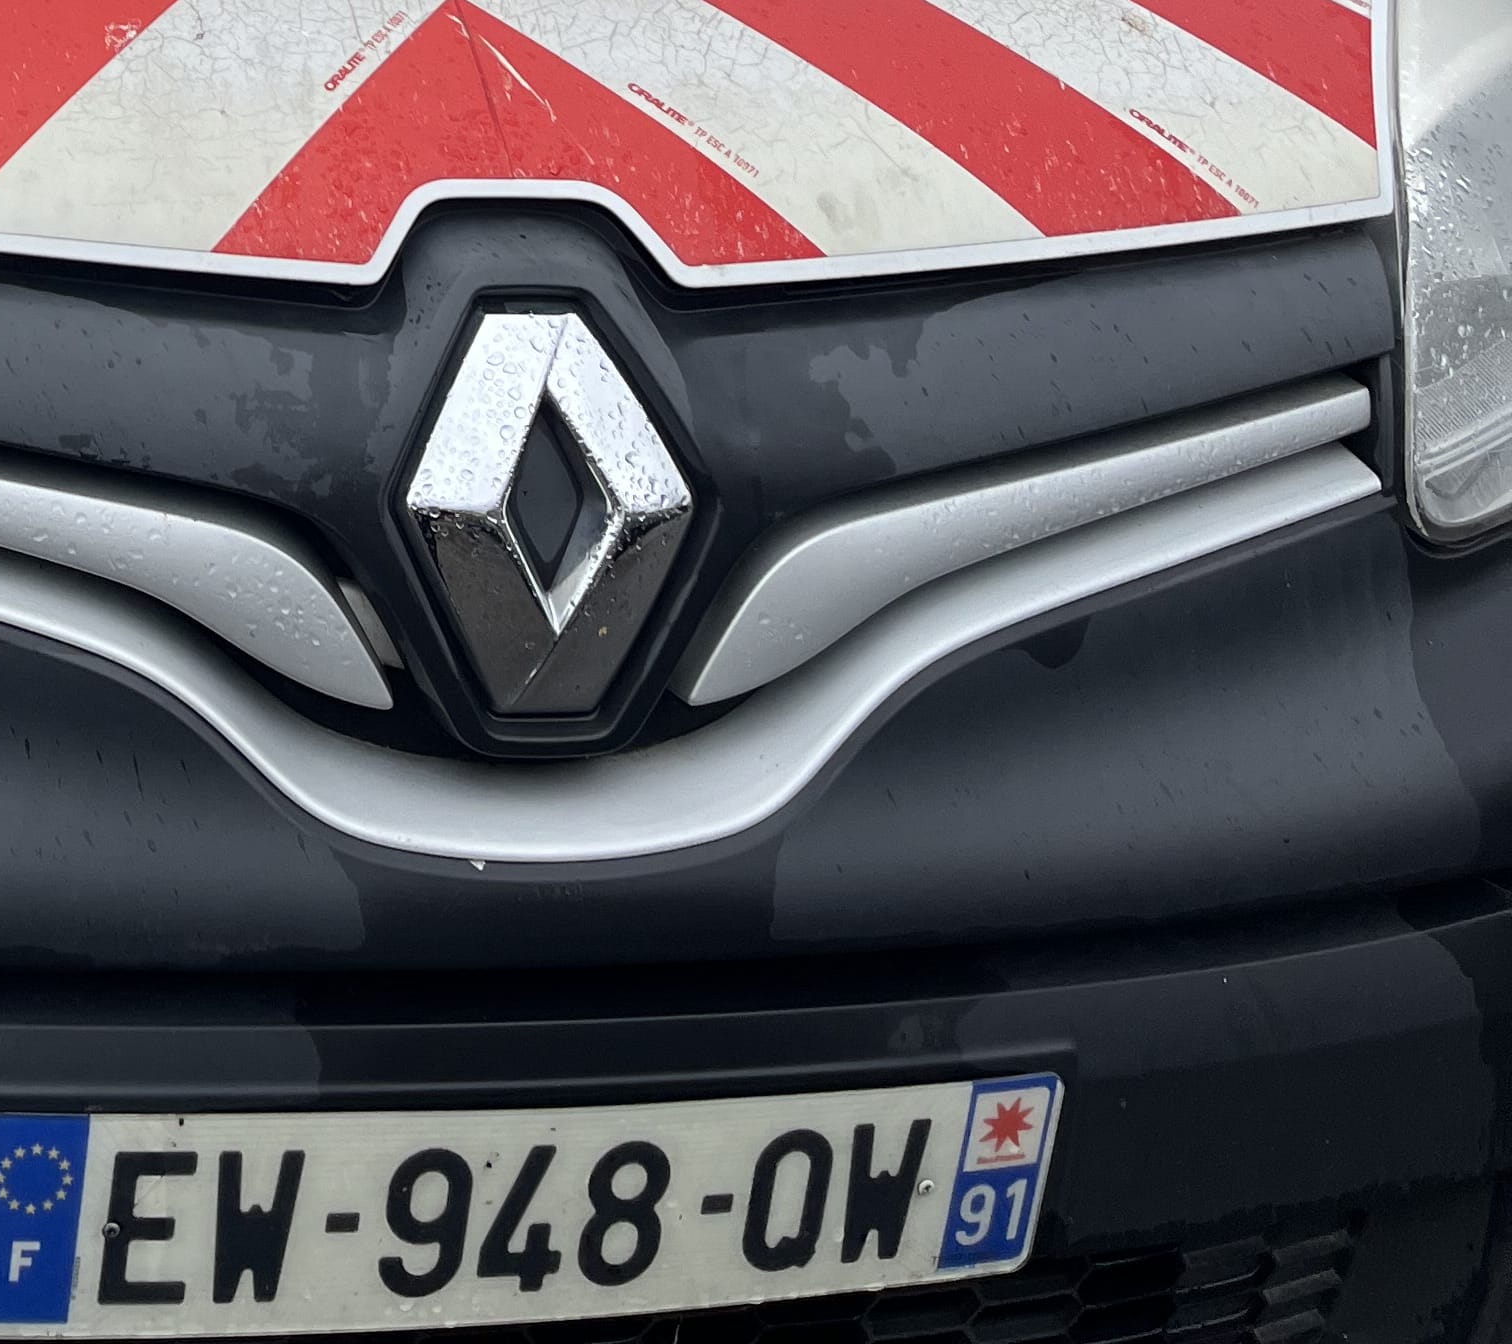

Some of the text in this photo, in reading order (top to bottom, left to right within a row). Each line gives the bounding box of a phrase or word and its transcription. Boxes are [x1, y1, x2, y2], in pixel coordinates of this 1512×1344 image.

[694, 126, 707, 139] TP
[706, 135, 726, 153] ESC
[723, 149, 732, 159] A
[1197, 155, 1209, 167] TP
[1226, 178, 1233, 188] A
[97, 1118, 932, 1304] EW-948-QW
[955, 1178, 1028, 1246] 91
[8, 1241, 40, 1283] F
